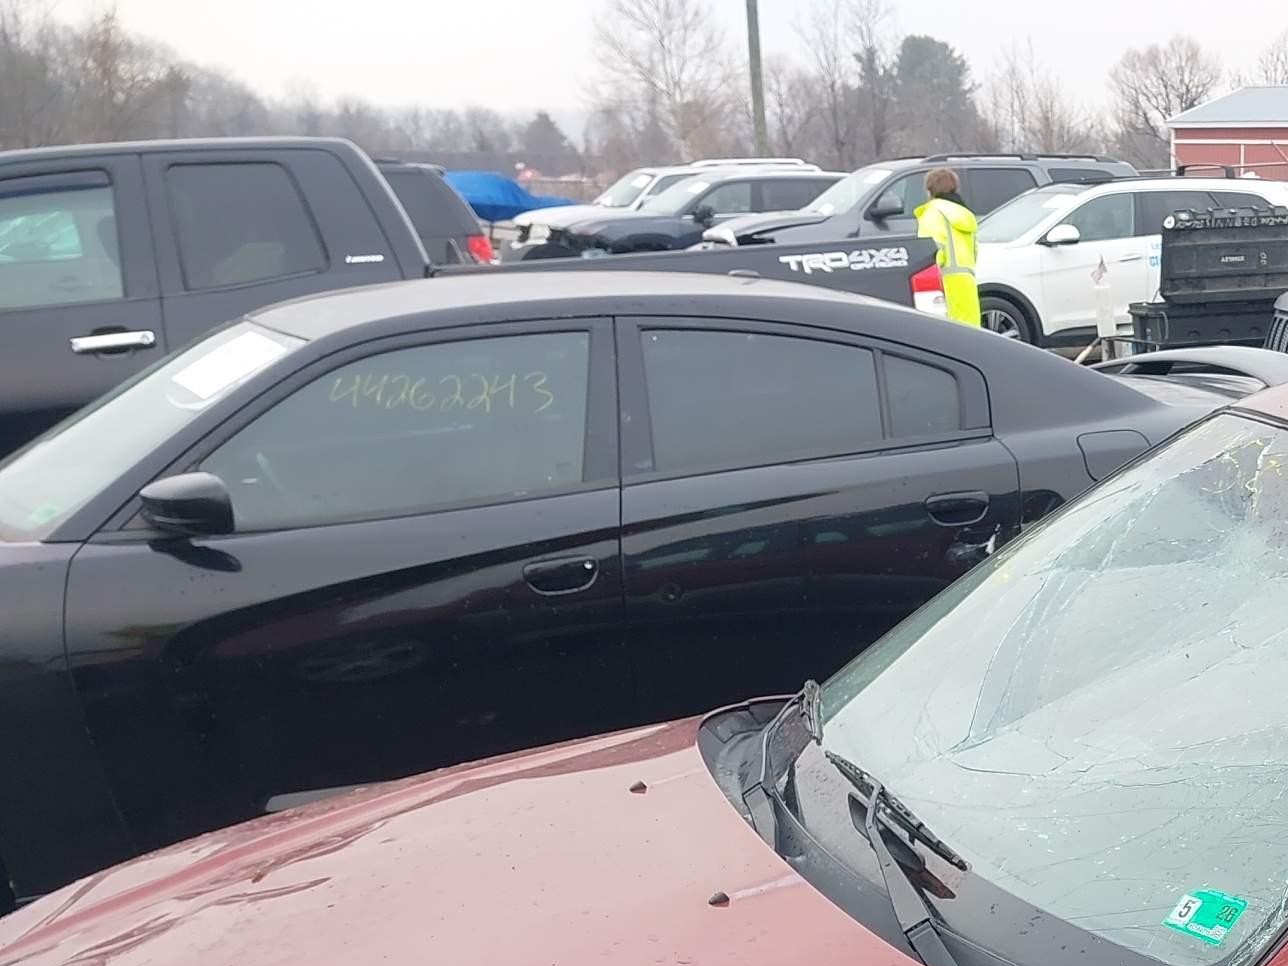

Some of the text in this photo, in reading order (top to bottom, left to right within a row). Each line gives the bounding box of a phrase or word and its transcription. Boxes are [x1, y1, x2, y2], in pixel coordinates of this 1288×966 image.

[779, 252, 849, 274] TRD
[1178, 899, 1238, 922] 5 26
